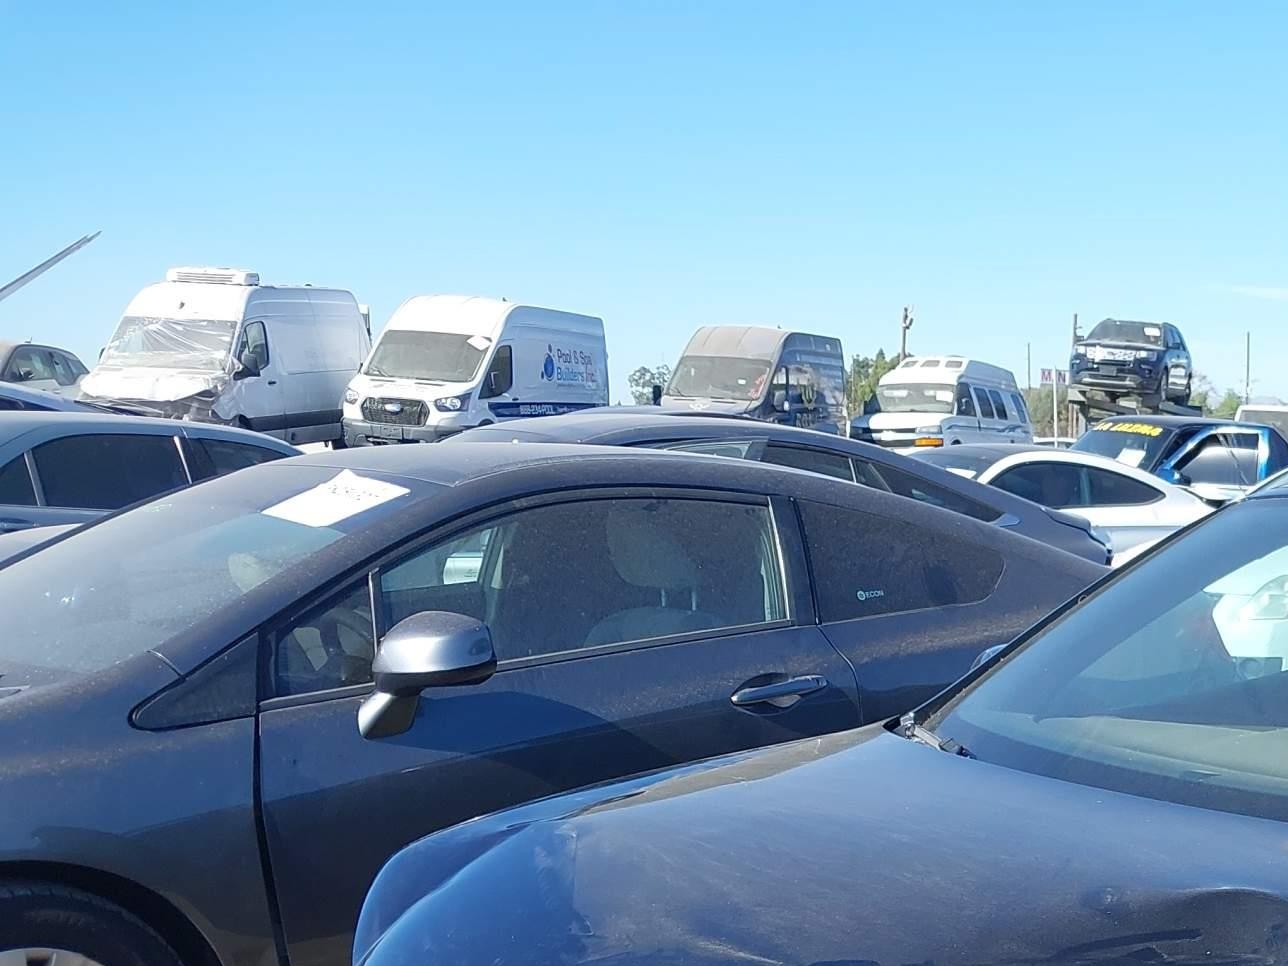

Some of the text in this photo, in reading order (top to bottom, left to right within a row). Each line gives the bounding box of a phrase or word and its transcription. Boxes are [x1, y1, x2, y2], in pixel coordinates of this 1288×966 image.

[556, 349, 572, 364] Pool
[579, 351, 592, 365] Spa
[556, 367, 584, 382] Builders
